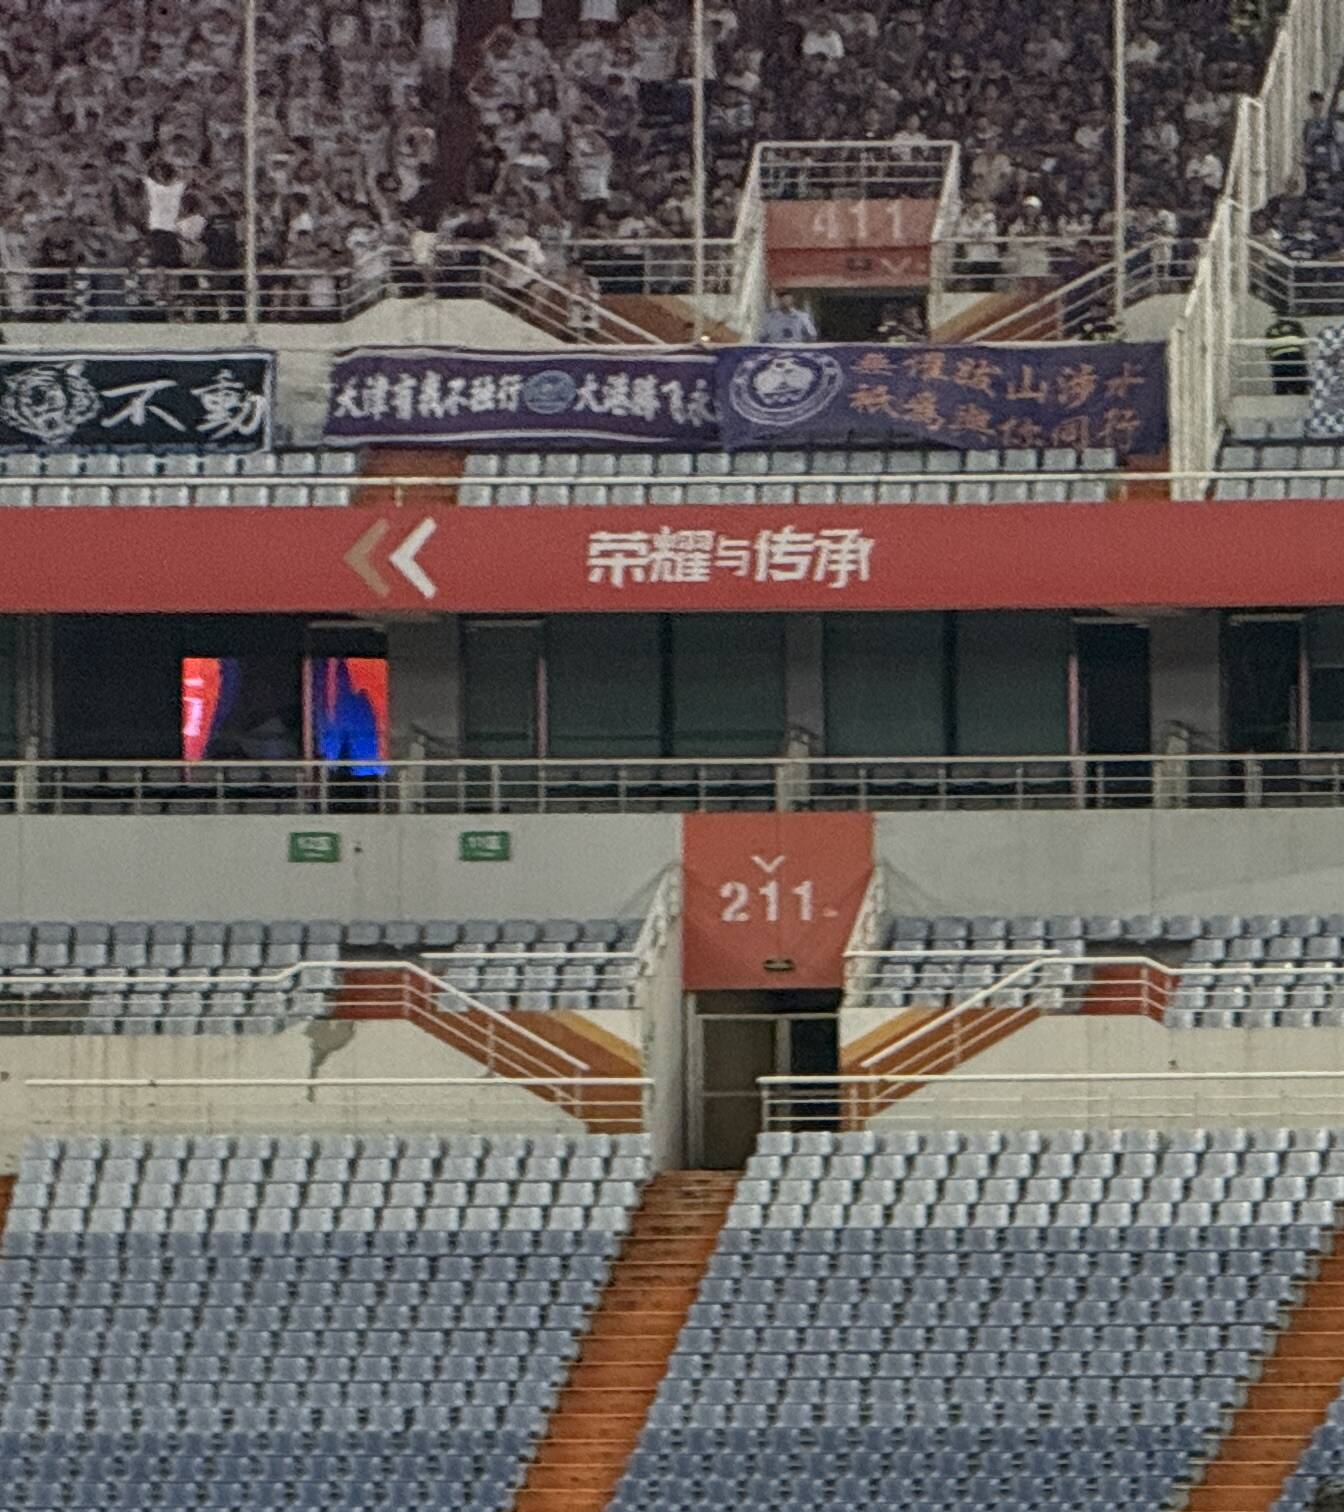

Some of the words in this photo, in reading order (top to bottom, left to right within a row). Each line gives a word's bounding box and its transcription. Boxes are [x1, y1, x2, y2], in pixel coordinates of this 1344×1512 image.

[812, 199, 901, 239] 411
[587, 526, 874, 588] 荣耀与传承
[721, 881, 814, 923] 211
